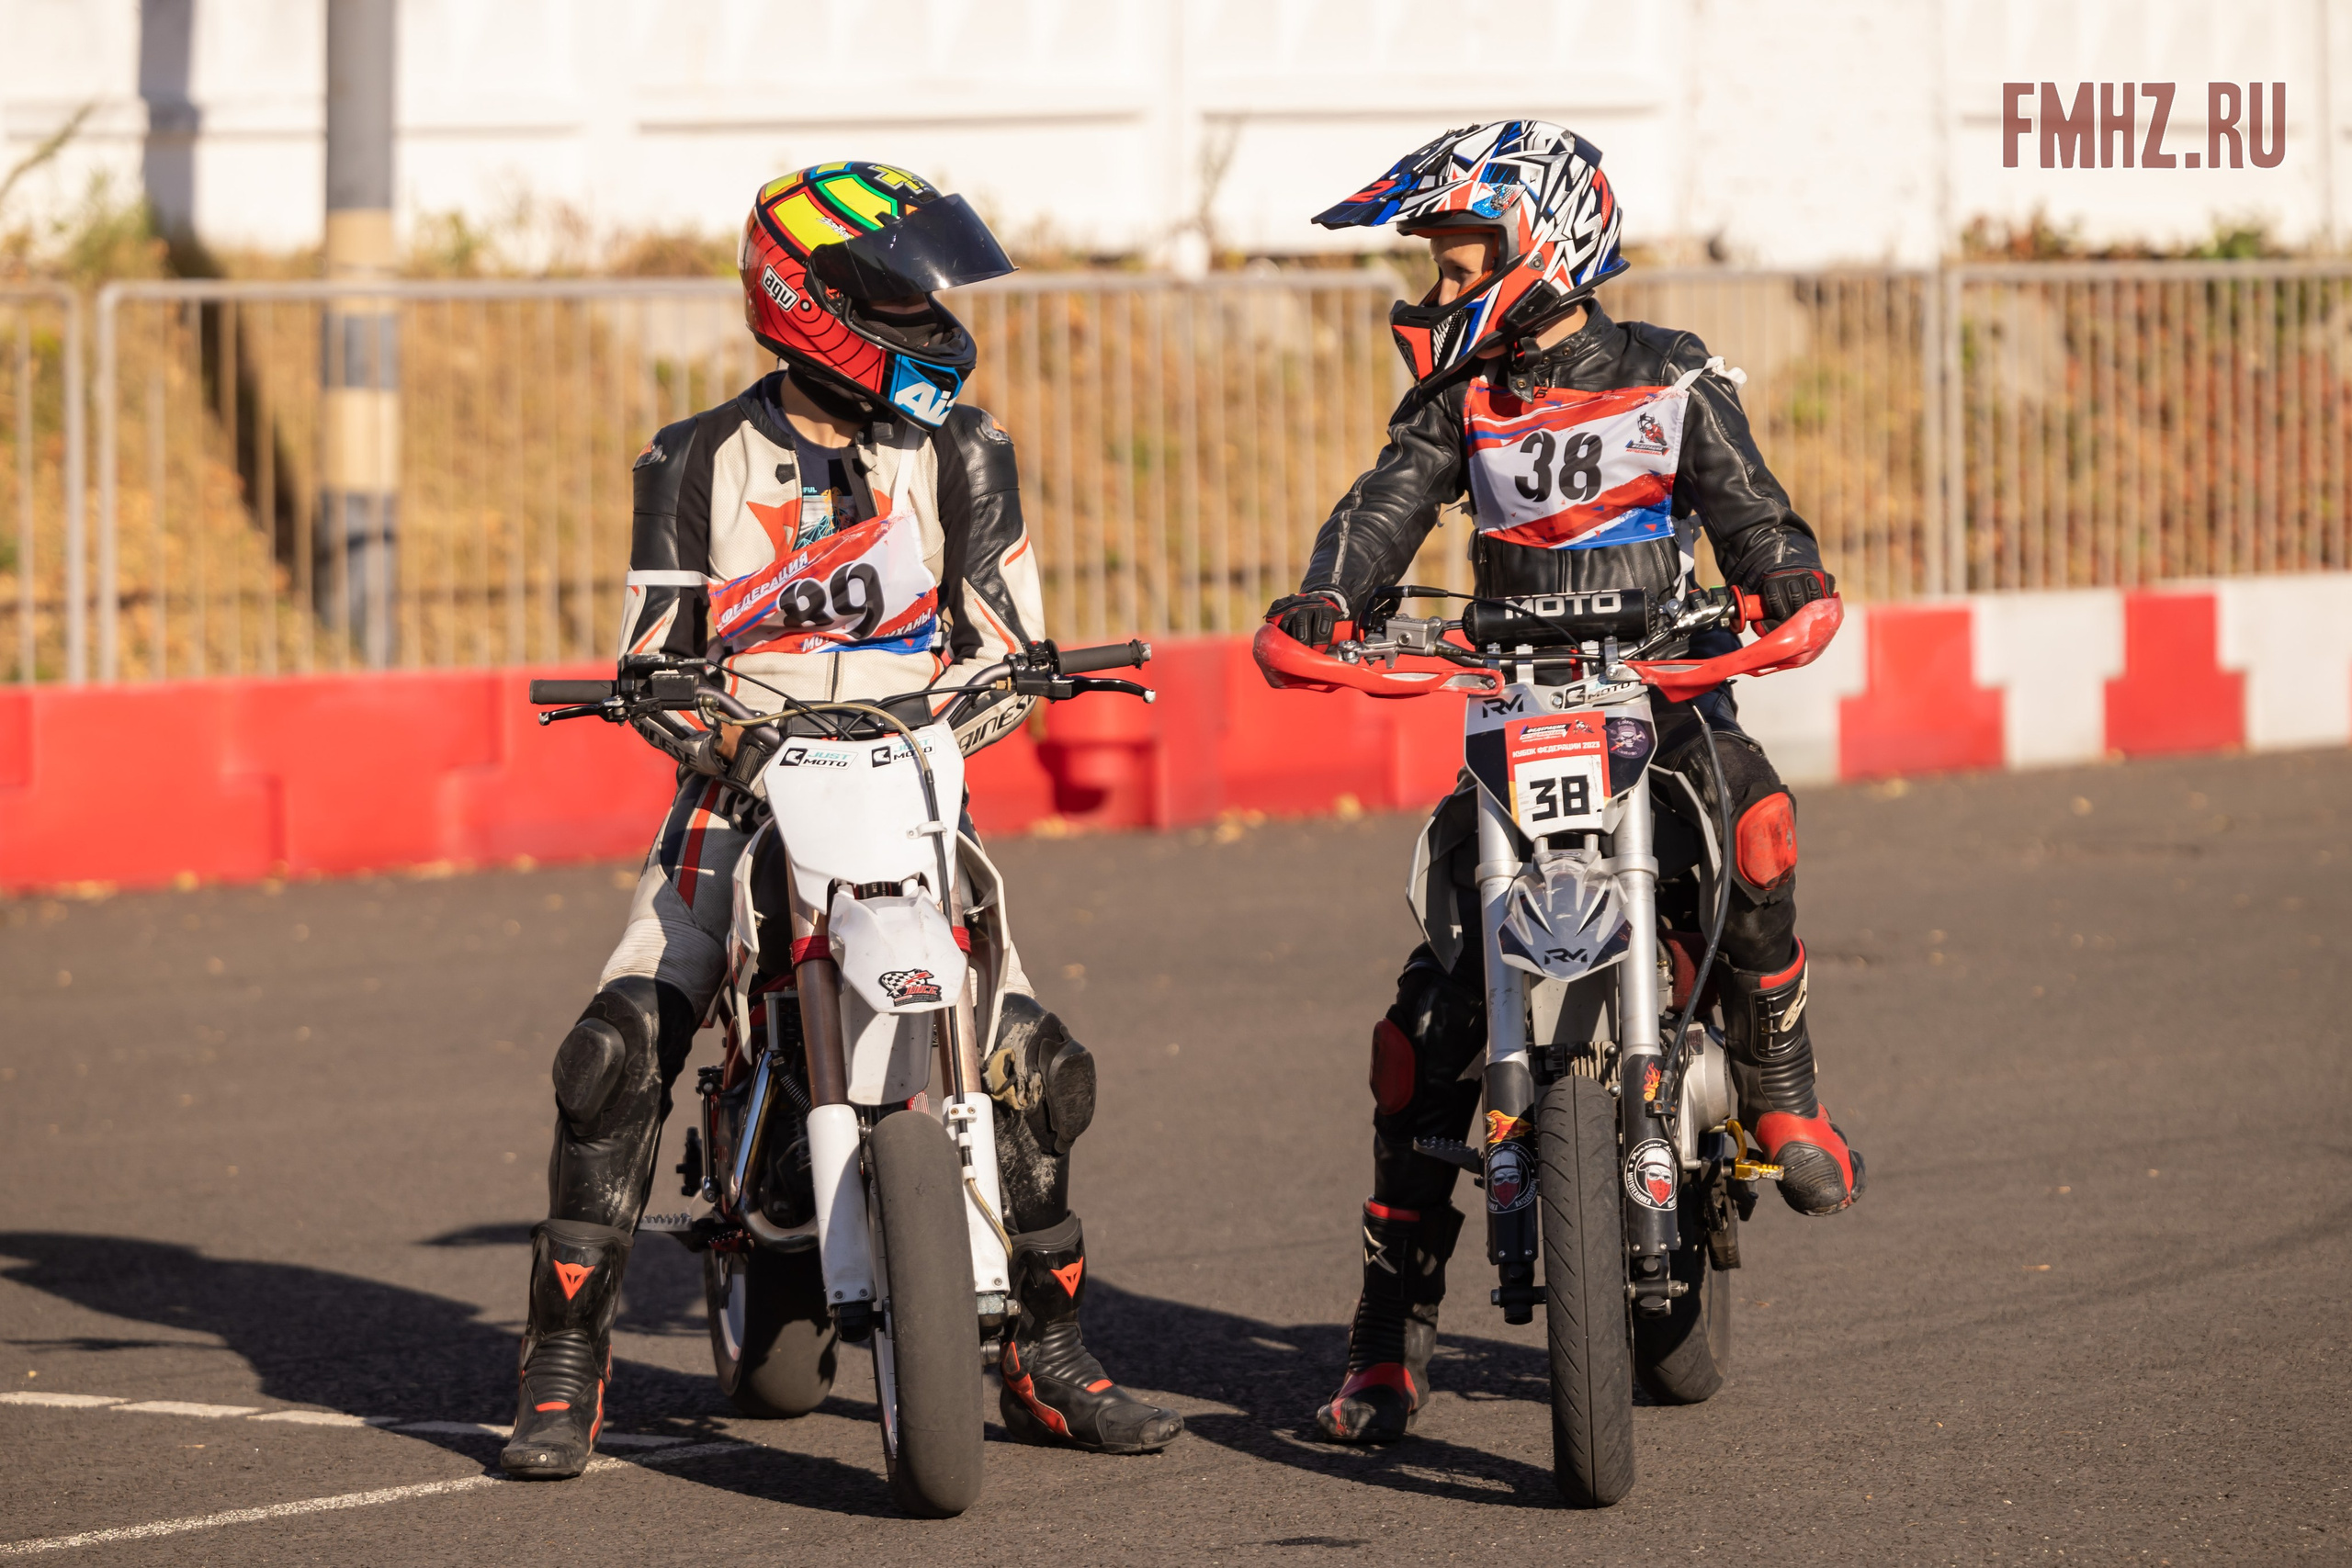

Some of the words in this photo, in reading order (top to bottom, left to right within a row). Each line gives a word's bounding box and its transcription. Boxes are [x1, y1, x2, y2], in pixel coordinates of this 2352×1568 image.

[764, 274, 794, 306] agv
[1514, 430, 1603, 502] 38
[802, 486, 818, 494] FUL
[720, 551, 809, 625] ФЕДЕРАЦИЯ
[778, 562, 885, 639] 89
[1505, 592, 1623, 620] MOTO
[957, 694, 1035, 751] AINES
[802, 759, 848, 768] MOTO
[807, 750, 852, 760] JUST
[893, 746, 933, 761] MOO
[1512, 747, 1537, 759] КУБОК
[1537, 742, 1582, 754] ФЕДЕРАЦИИ
[1583, 740, 1600, 750] 2023
[1529, 773, 1590, 822] 38
